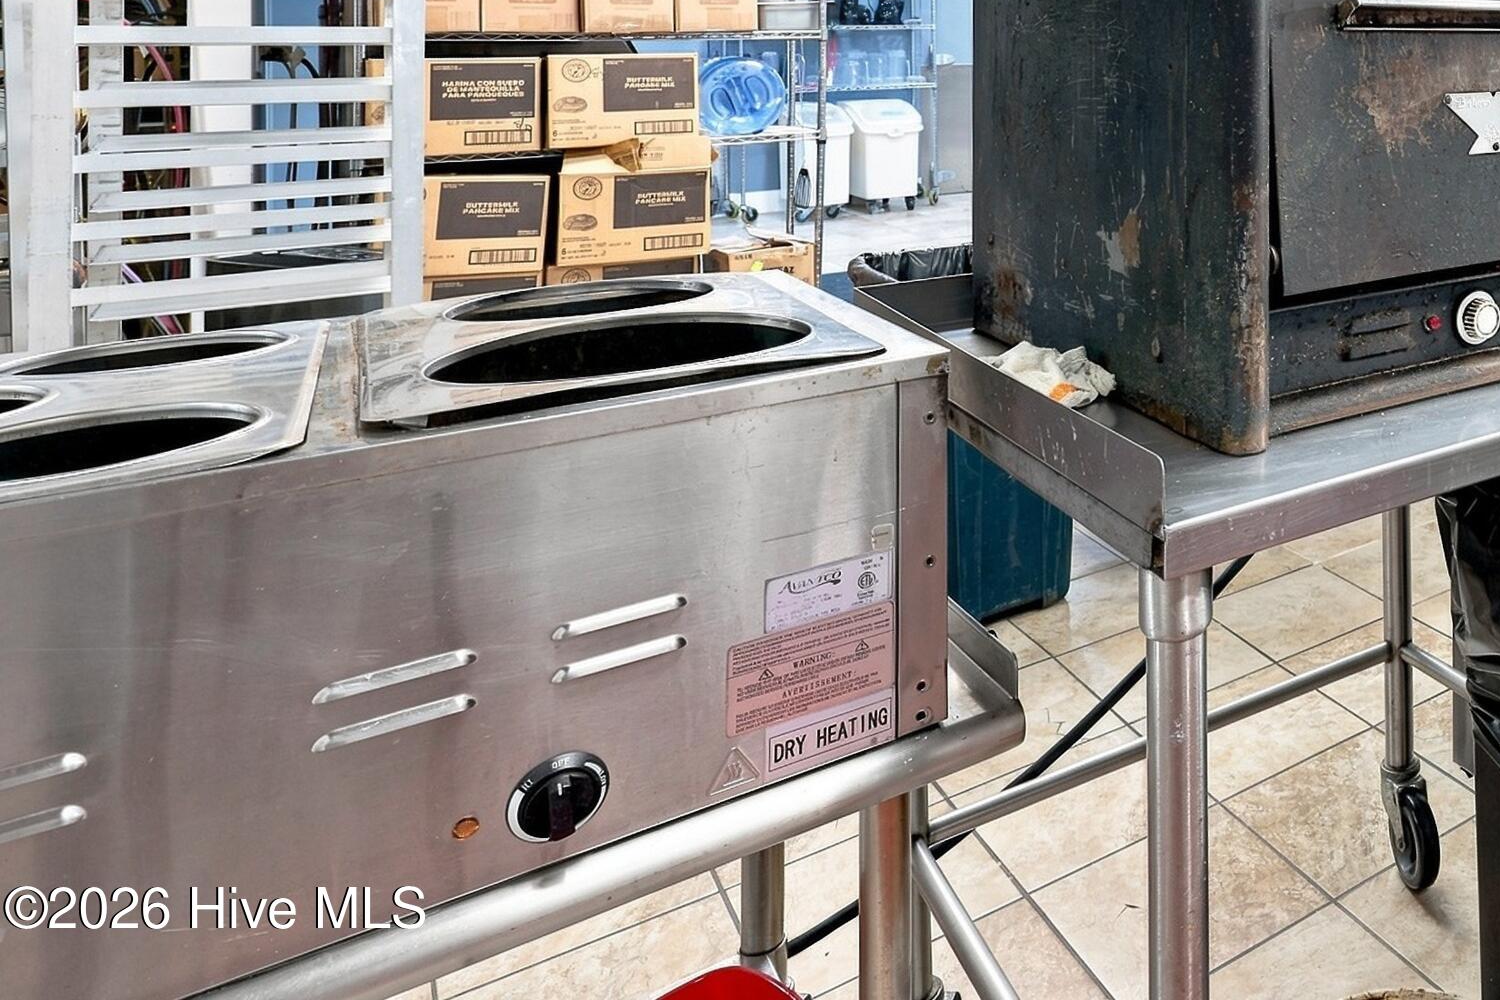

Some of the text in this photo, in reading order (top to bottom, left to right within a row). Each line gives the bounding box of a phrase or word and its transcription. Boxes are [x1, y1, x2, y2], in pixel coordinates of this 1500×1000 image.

[637, 191, 684, 199] BUTTERMILK
[774, 707, 888, 763] DRY HEATING
[551, 757, 570, 769] OFF
